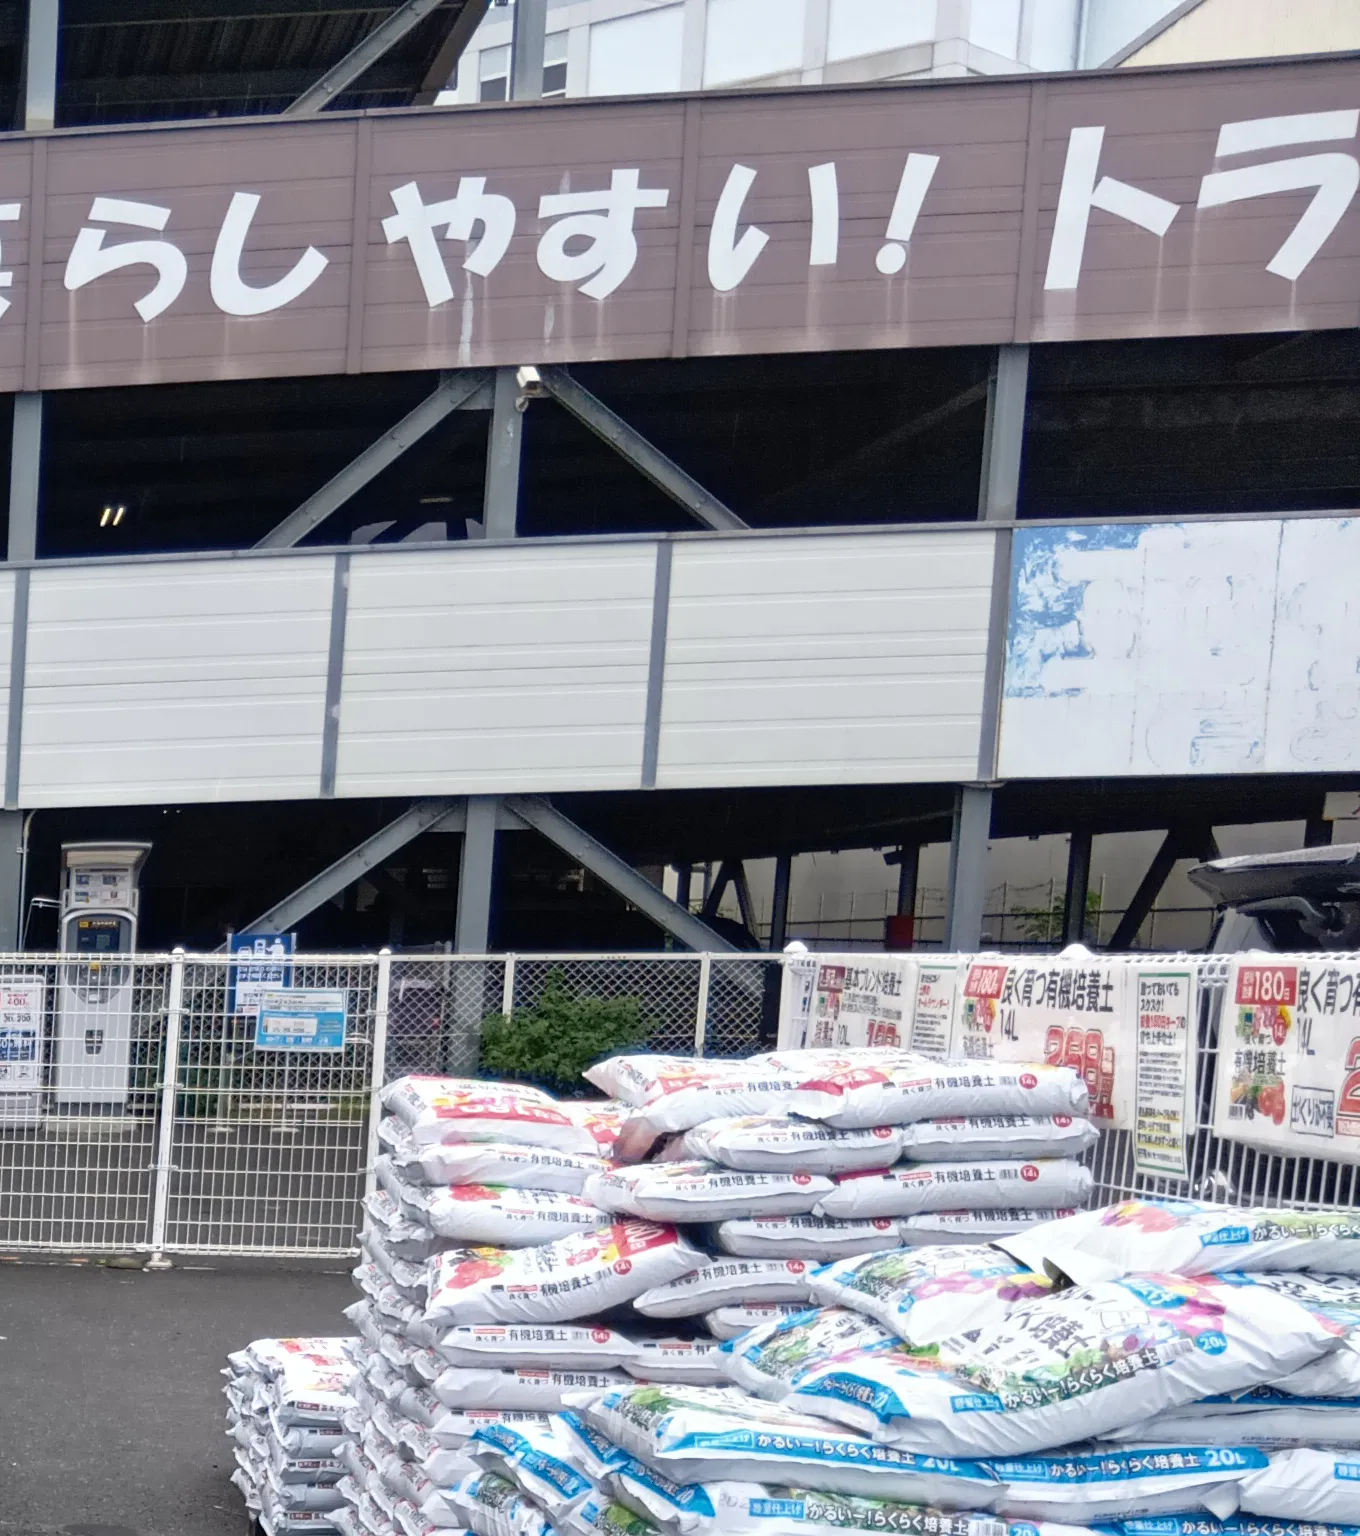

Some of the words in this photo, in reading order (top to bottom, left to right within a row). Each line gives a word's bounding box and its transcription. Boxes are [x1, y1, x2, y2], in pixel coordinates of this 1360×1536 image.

[1001, 968, 1114, 1012] 良く育つ有機培養土
[935, 1075, 996, 1090] 有機培養土
[708, 1172, 769, 1187] 有機培養土
[934, 1168, 997, 1183] 有機培養土
[537, 1210, 593, 1224] 有機培養土
[701, 1262, 763, 1278] 有機培養土
[540, 1275, 593, 1297] 有機培養土
[509, 1329, 568, 1342] 有機培養土
[551, 1372, 610, 1388] 有機培養土
[1205, 1449, 1247, 1467] 20L
